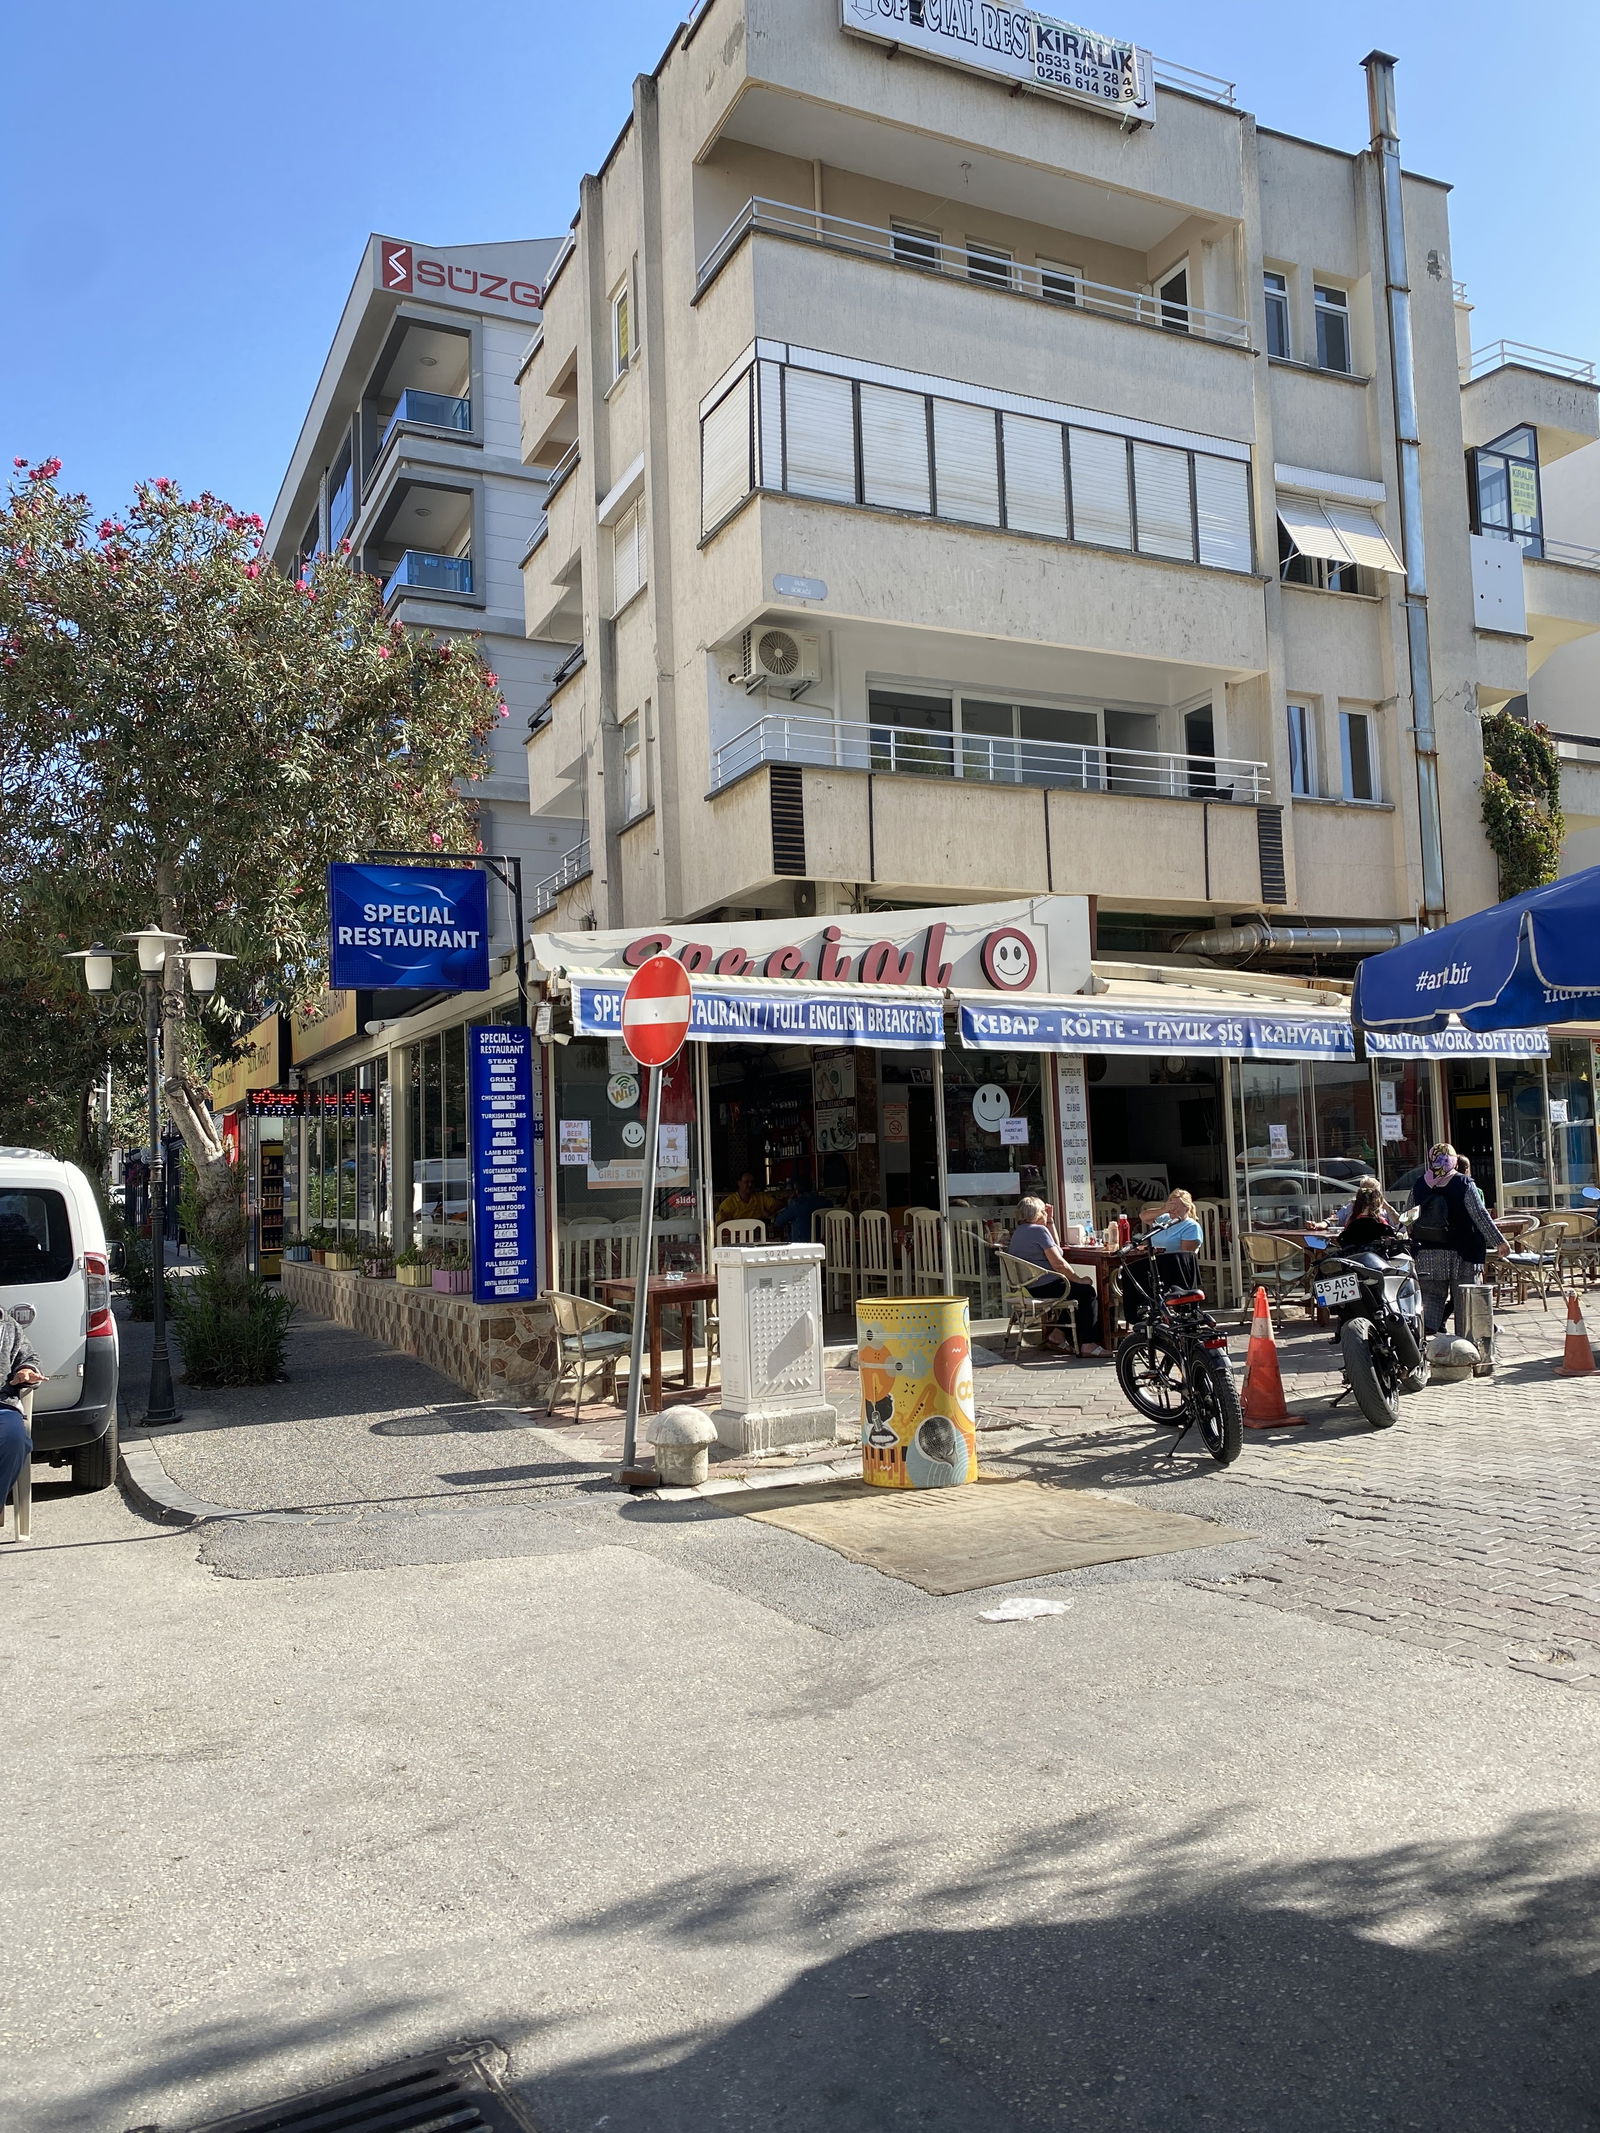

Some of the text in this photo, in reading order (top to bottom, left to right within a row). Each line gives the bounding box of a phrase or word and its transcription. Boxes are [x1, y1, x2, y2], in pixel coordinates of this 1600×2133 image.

[877, 0, 978, 46] SPCIAL
[1036, 51, 1071, 71] 0533
[1074, 62, 1100, 79] 502
[1102, 71, 1119, 85] 28
[1037, 65, 1071, 85] 0256
[1075, 78, 1100, 94] 614
[1103, 85, 1120, 99] 99
[416, 260, 546, 308] SÜZG
[363, 903, 455, 925] SPECIAL
[338, 926, 480, 949] RESTAURANT
[690, 1001, 762, 1028] TAURANT
[773, 1002, 806, 1030] FULL
[809, 1004, 864, 1032] ENGLISH
[867, 1009, 940, 1035] BREAKFAST
[480, 1033, 511, 1044] SPECIAL
[972, 1014, 1040, 1036] KEBAP
[1061, 1013, 1126, 1038] KÖFTE
[1144, 1021, 1214, 1041] TAVUK
[1260, 1025, 1350, 1049] KAHVALTI
[480, 1045, 524, 1054] RESTAURANT
[1376, 1032, 1550, 1051] DENTAL WORK SOFT FOODS
[565, 1154, 576, 1162] 100
[662, 1155, 681, 1163] 15 TL
[499, 1259, 528, 1267] BREAKFAST
[1317, 1276, 1356, 1294] 35 ARS
[1333, 1291, 1348, 1302] 74
